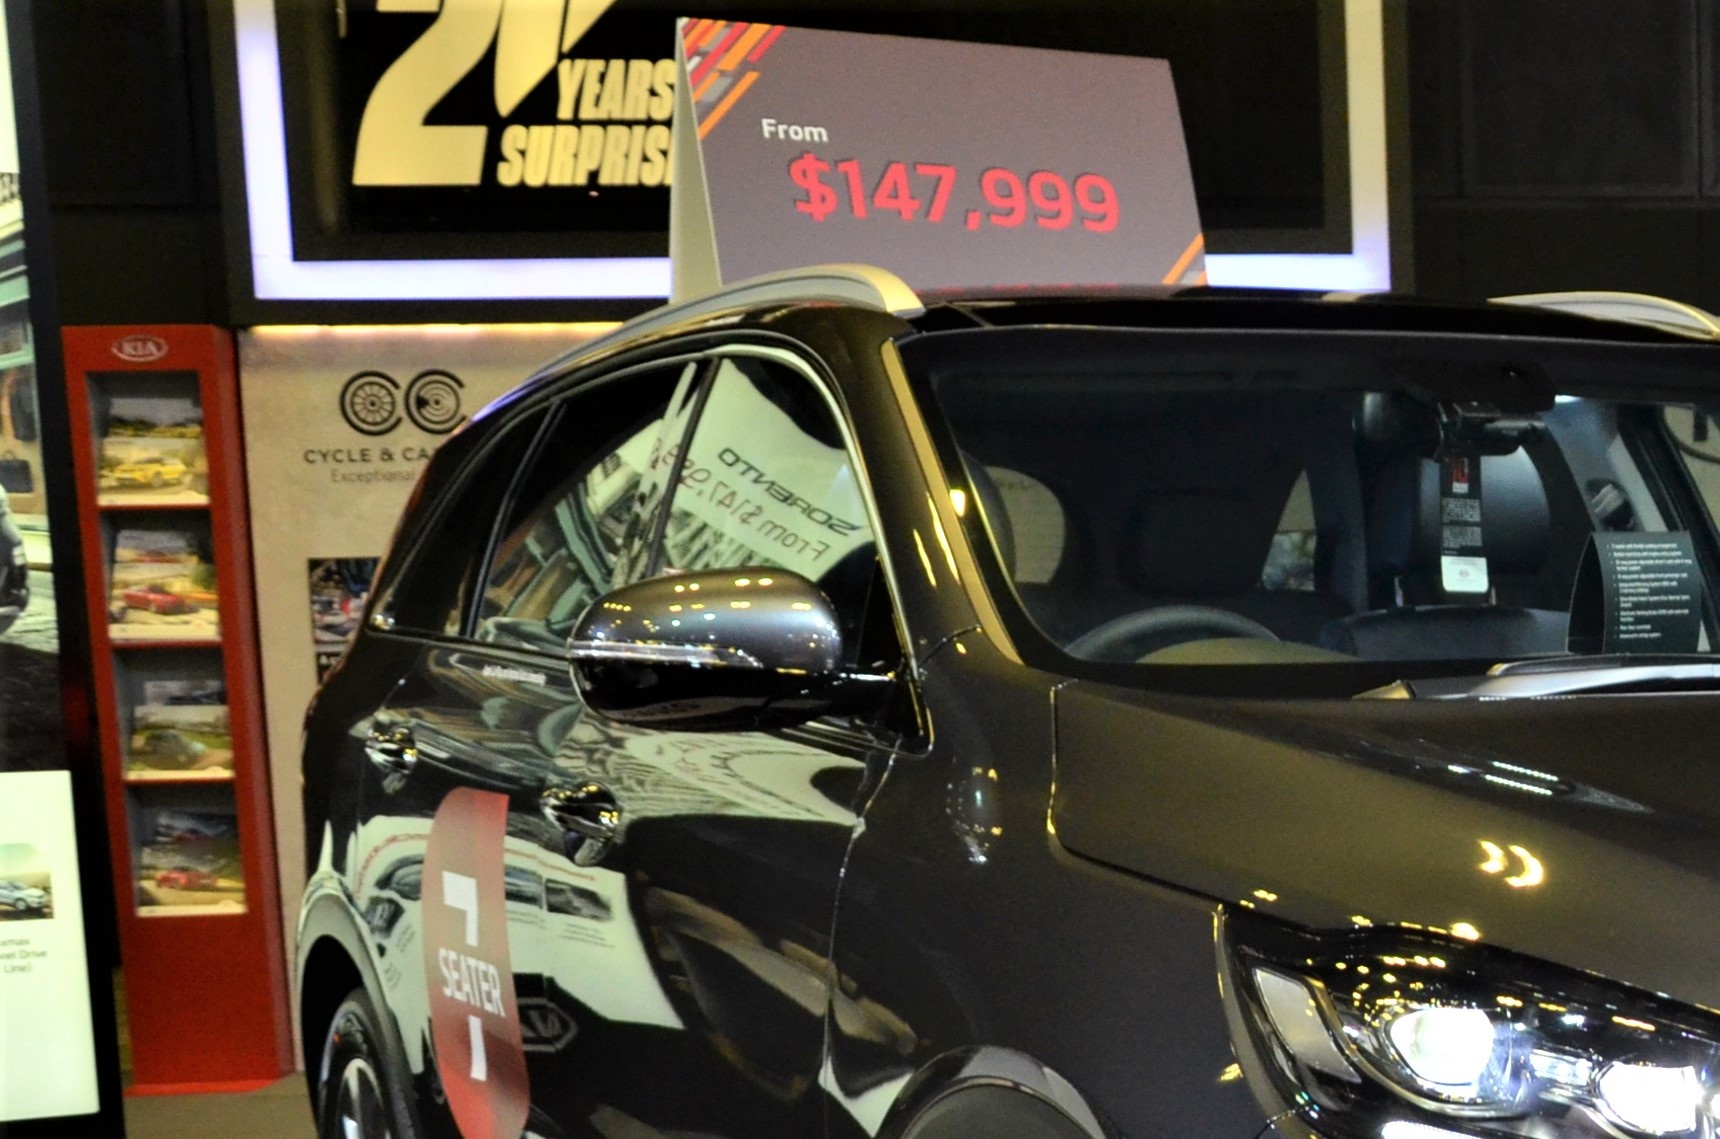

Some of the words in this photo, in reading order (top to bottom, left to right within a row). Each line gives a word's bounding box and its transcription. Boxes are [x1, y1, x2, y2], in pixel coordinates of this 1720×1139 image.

[556, 58, 676, 120] YEARS
[496, 124, 673, 187] SURPRIS
[761, 118, 829, 142] From
[788, 152, 1120, 233] $147,999
[304, 449, 372, 464] CYCLE
[380, 447, 395, 463] &
[438, 947, 506, 1018] SEATER
